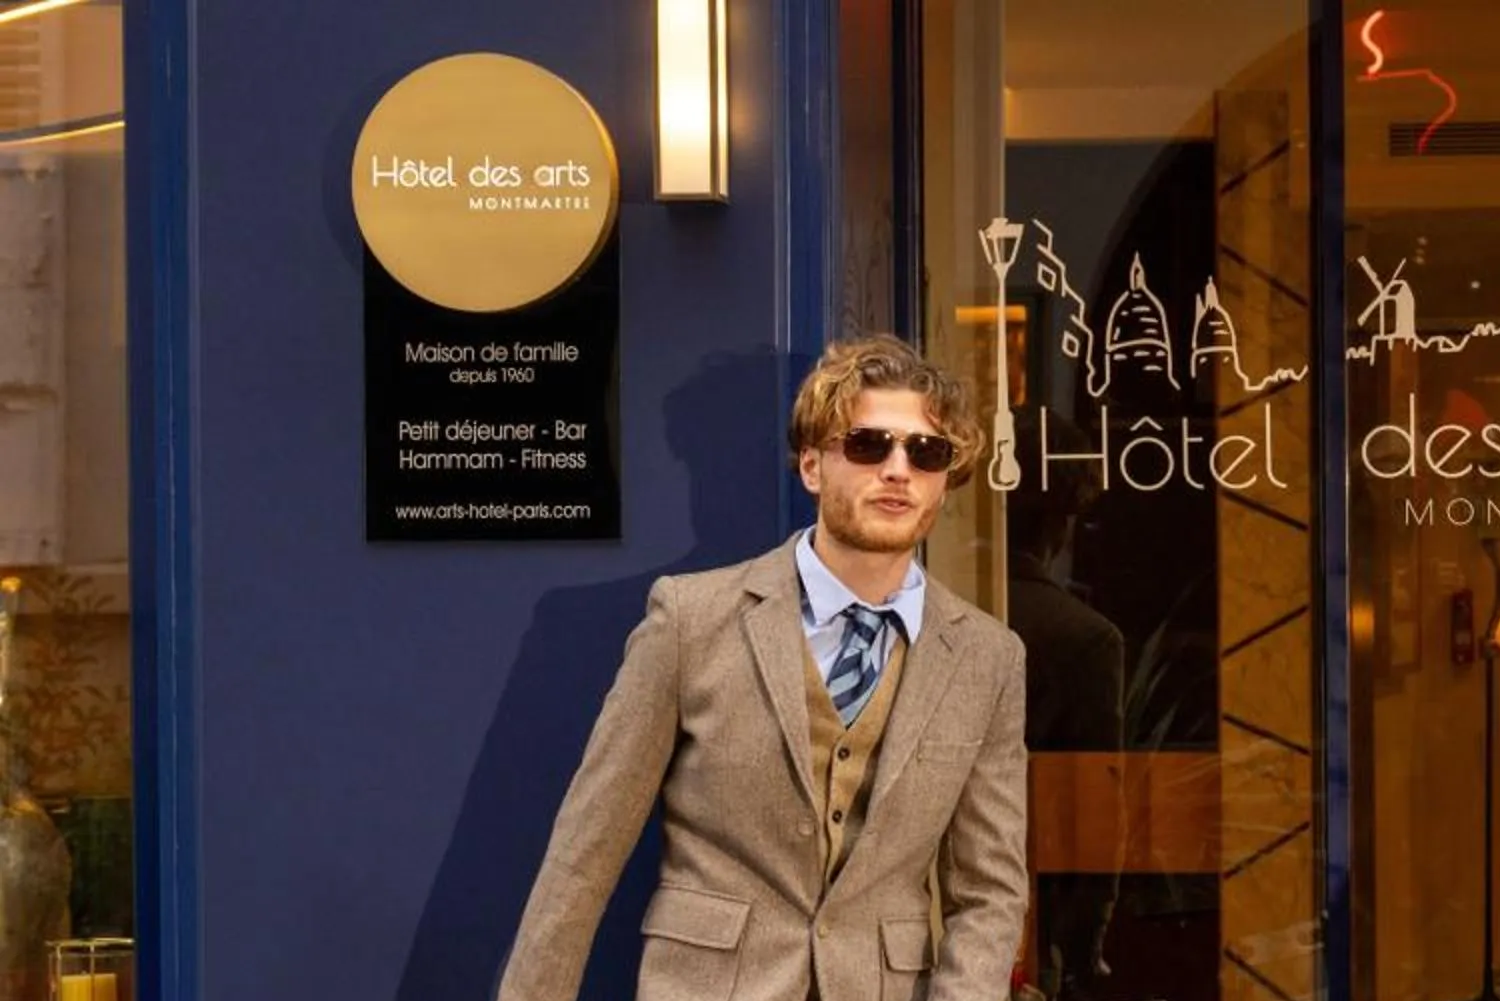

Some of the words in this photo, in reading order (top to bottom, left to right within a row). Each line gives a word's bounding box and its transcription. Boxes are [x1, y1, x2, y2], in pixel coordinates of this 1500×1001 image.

[372, 155, 457, 188] Hôtel
[468, 155, 522, 187] des
[533, 160, 590, 187] arts
[469, 197, 590, 210] MONTMARTRE
[405, 342, 475, 363] Maison
[480, 341, 508, 363] de
[513, 341, 579, 362] famille
[449, 368, 497, 385] depuis
[501, 367, 535, 383] 1960
[399, 420, 439, 441] Petit
[445, 419, 536, 445] déjeuner
[555, 420, 588, 441] Bar
[1040, 402, 1288, 492] Hôtel
[399, 450, 503, 470] Hammam
[521, 449, 587, 469] Fitness
[395, 503, 591, 522] www.arts-hotel-paris.com
